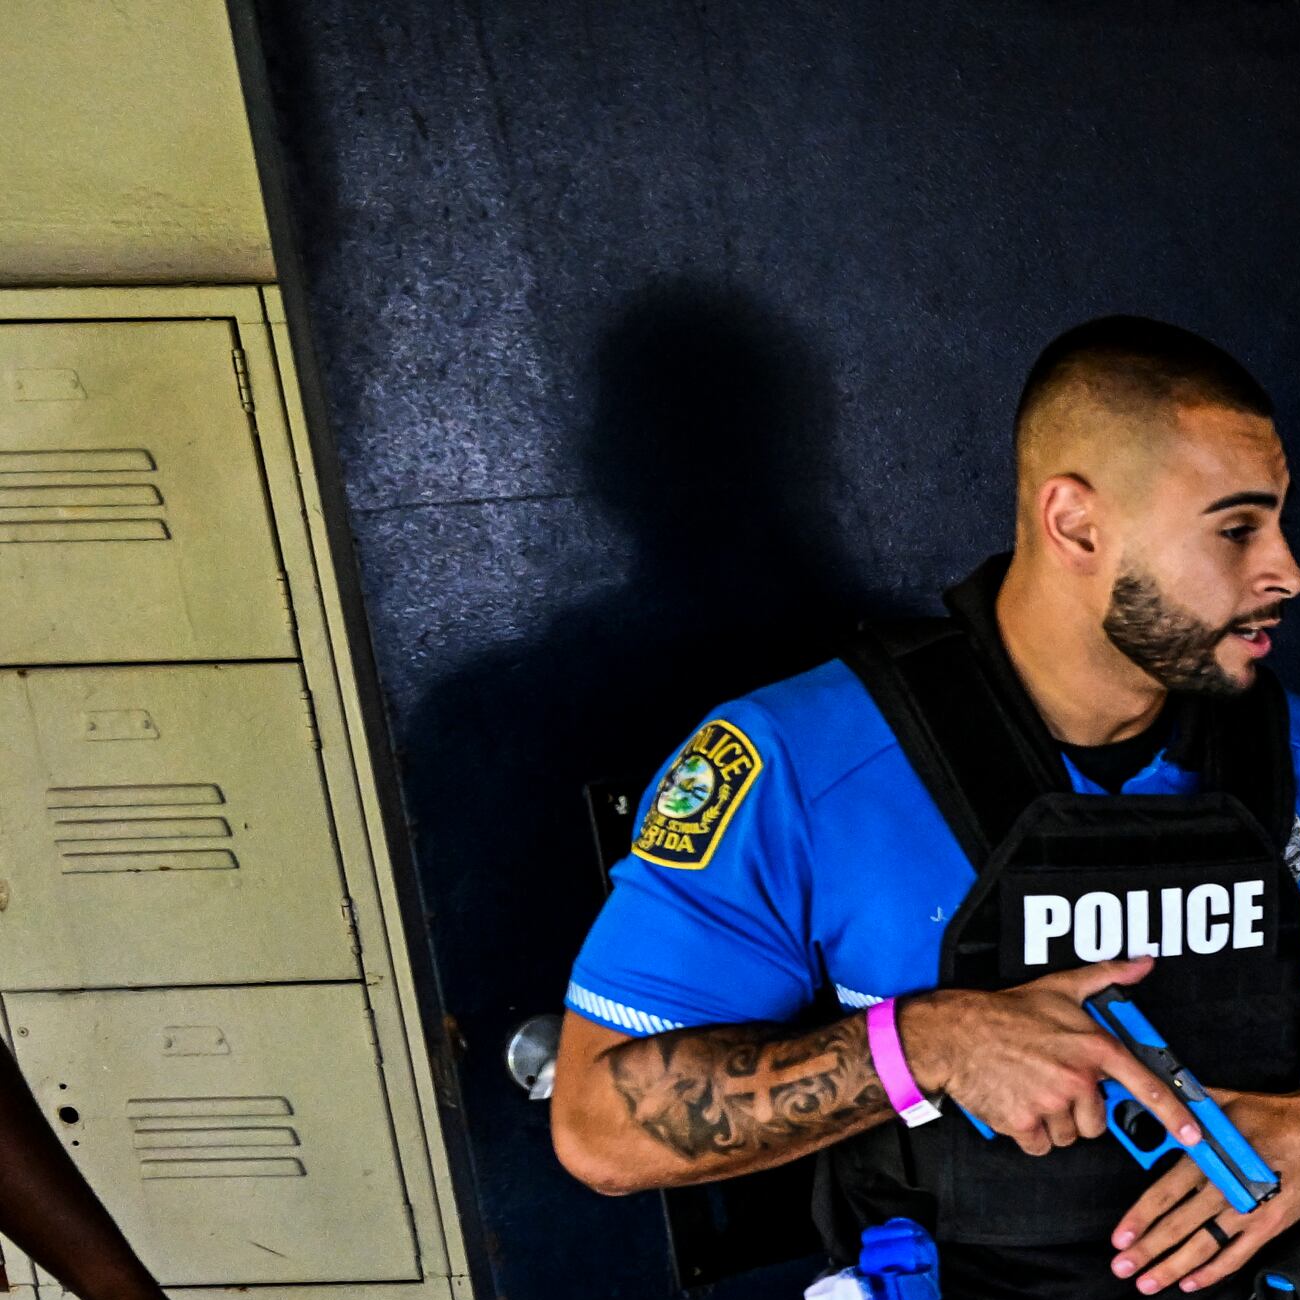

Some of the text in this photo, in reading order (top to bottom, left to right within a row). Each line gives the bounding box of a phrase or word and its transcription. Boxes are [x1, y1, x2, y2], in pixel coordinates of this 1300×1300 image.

[683, 727, 754, 782] OLICE
[641, 824, 695, 854] RIDA
[1024, 880, 1265, 966] POLICE
